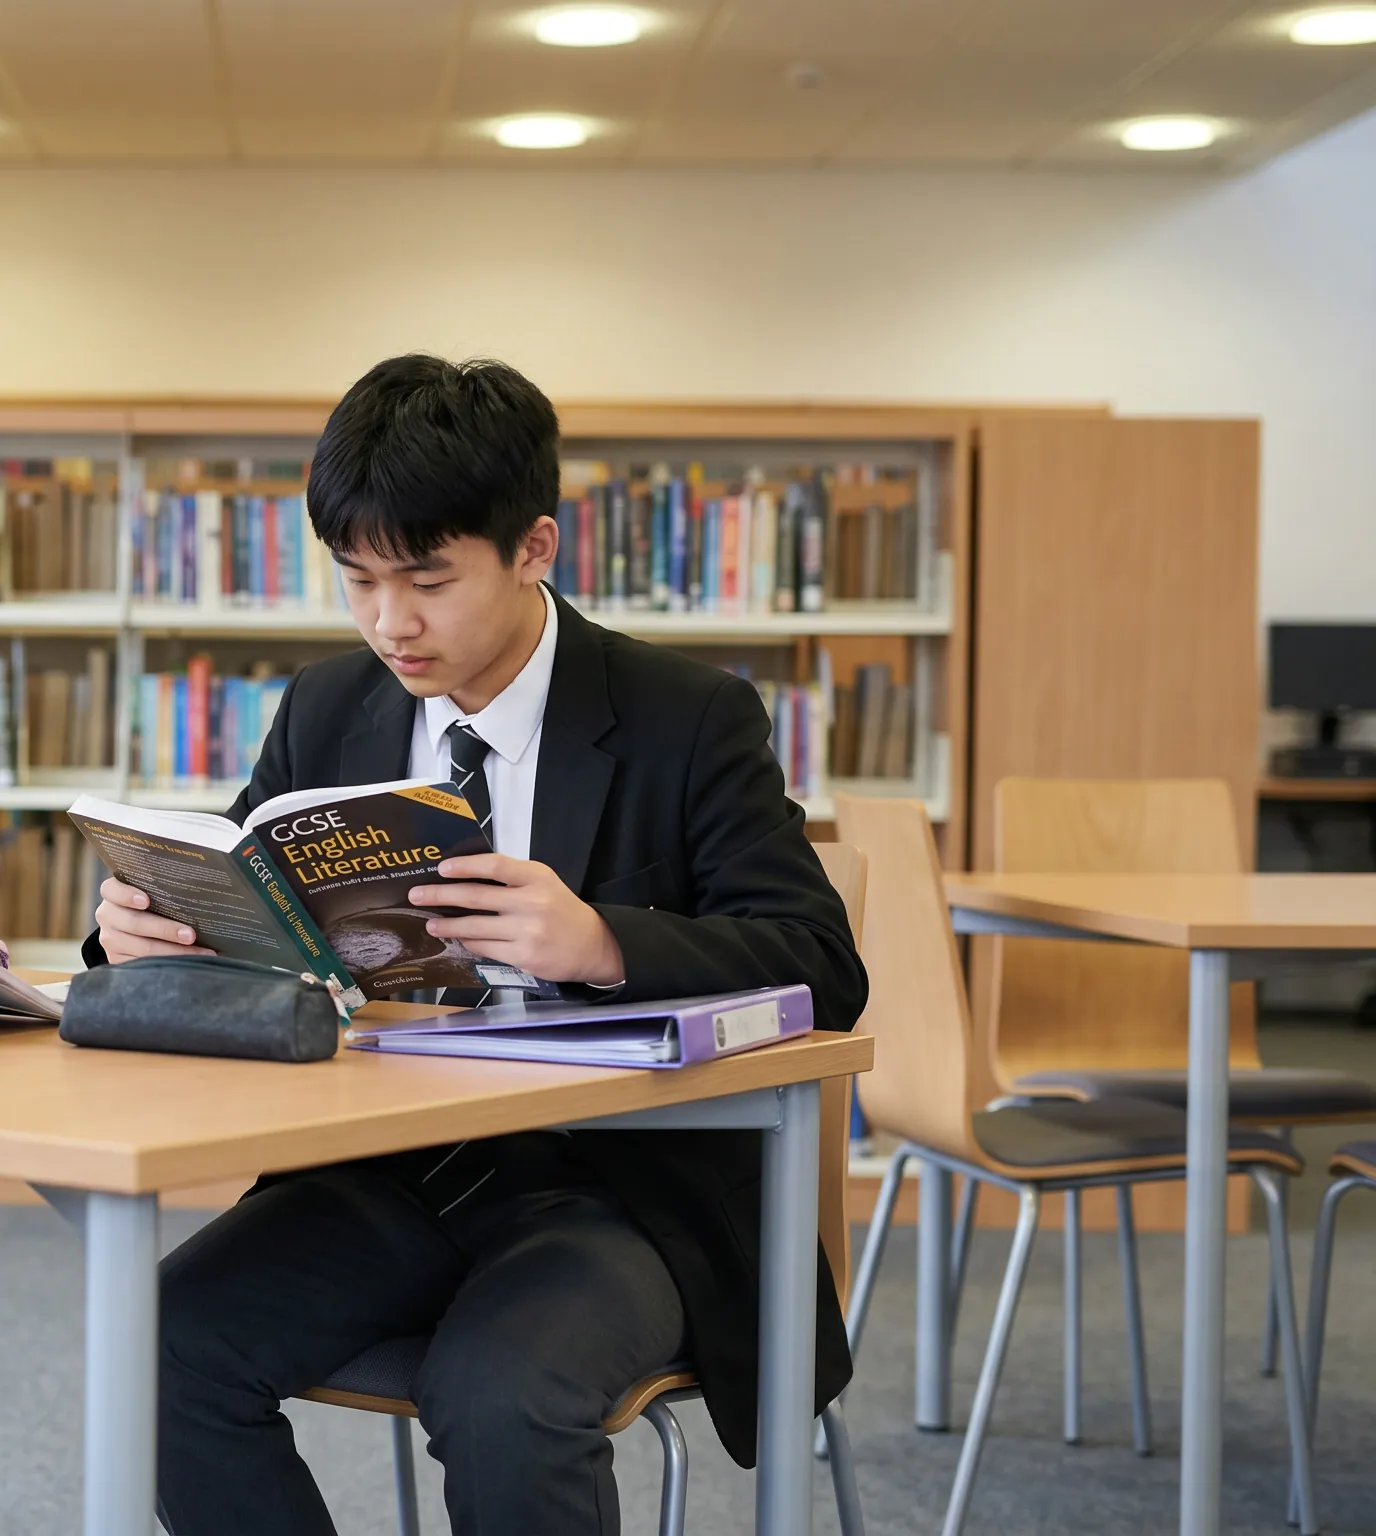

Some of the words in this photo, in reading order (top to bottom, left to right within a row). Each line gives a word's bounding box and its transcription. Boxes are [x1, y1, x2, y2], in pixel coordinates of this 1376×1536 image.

[270, 809, 347, 842] GCSE
[282, 825, 391, 864] English
[295, 843, 442, 885] Literature
